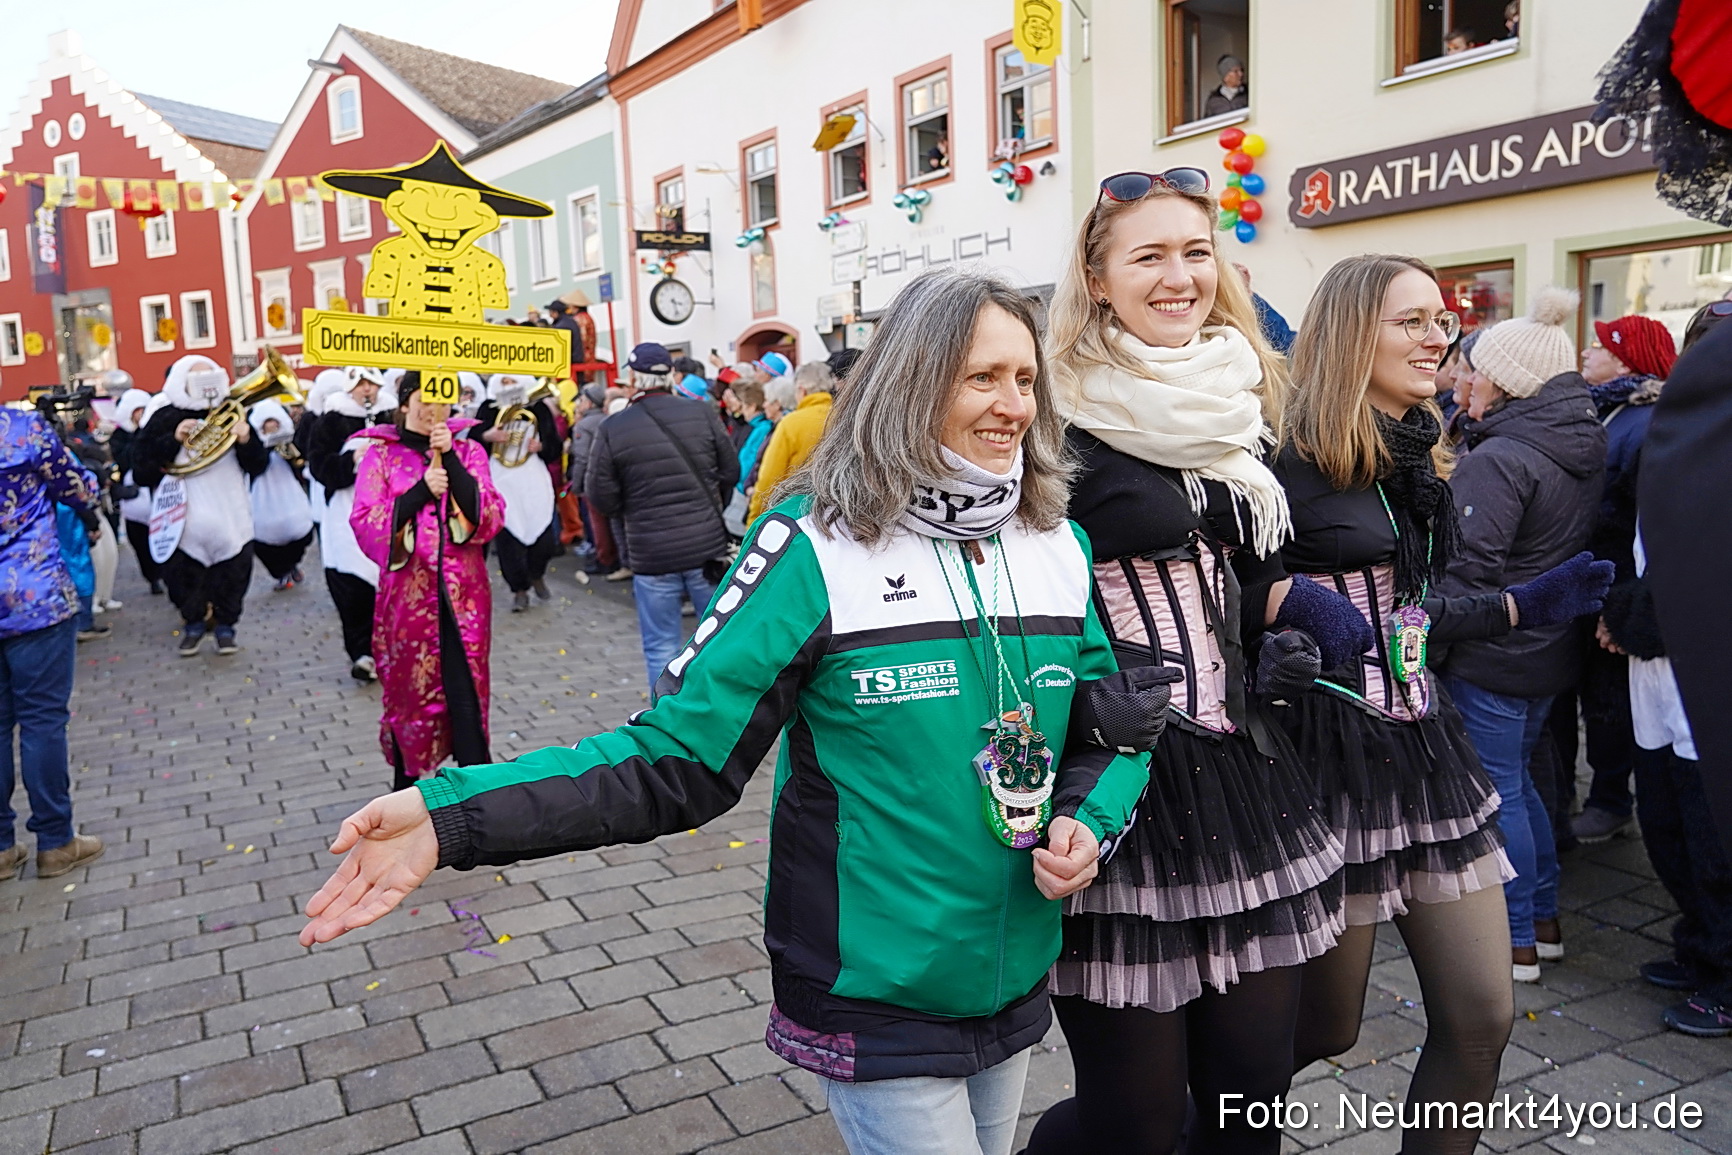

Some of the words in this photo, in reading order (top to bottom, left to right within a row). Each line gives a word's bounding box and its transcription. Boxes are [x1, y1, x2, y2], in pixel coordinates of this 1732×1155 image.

[1338, 133, 1524, 208] RATHAUS
[866, 227, 1011, 276] RÖHLICH
[321, 327, 449, 357] Dorfmusikanten
[453, 336, 554, 366] Seligenporten
[424, 377, 455, 399] 40
[882, 590, 917, 603] erima
[899, 662, 957, 677] SPORTS
[851, 670, 897, 693] TS
[900, 676, 959, 690] Fashion
[1045, 678, 1071, 687] Deutsch
[855, 687, 960, 705] www.ts-sportsfashion.de
[994, 735, 1048, 790] 35
[1016, 835, 1034, 846] 2023
